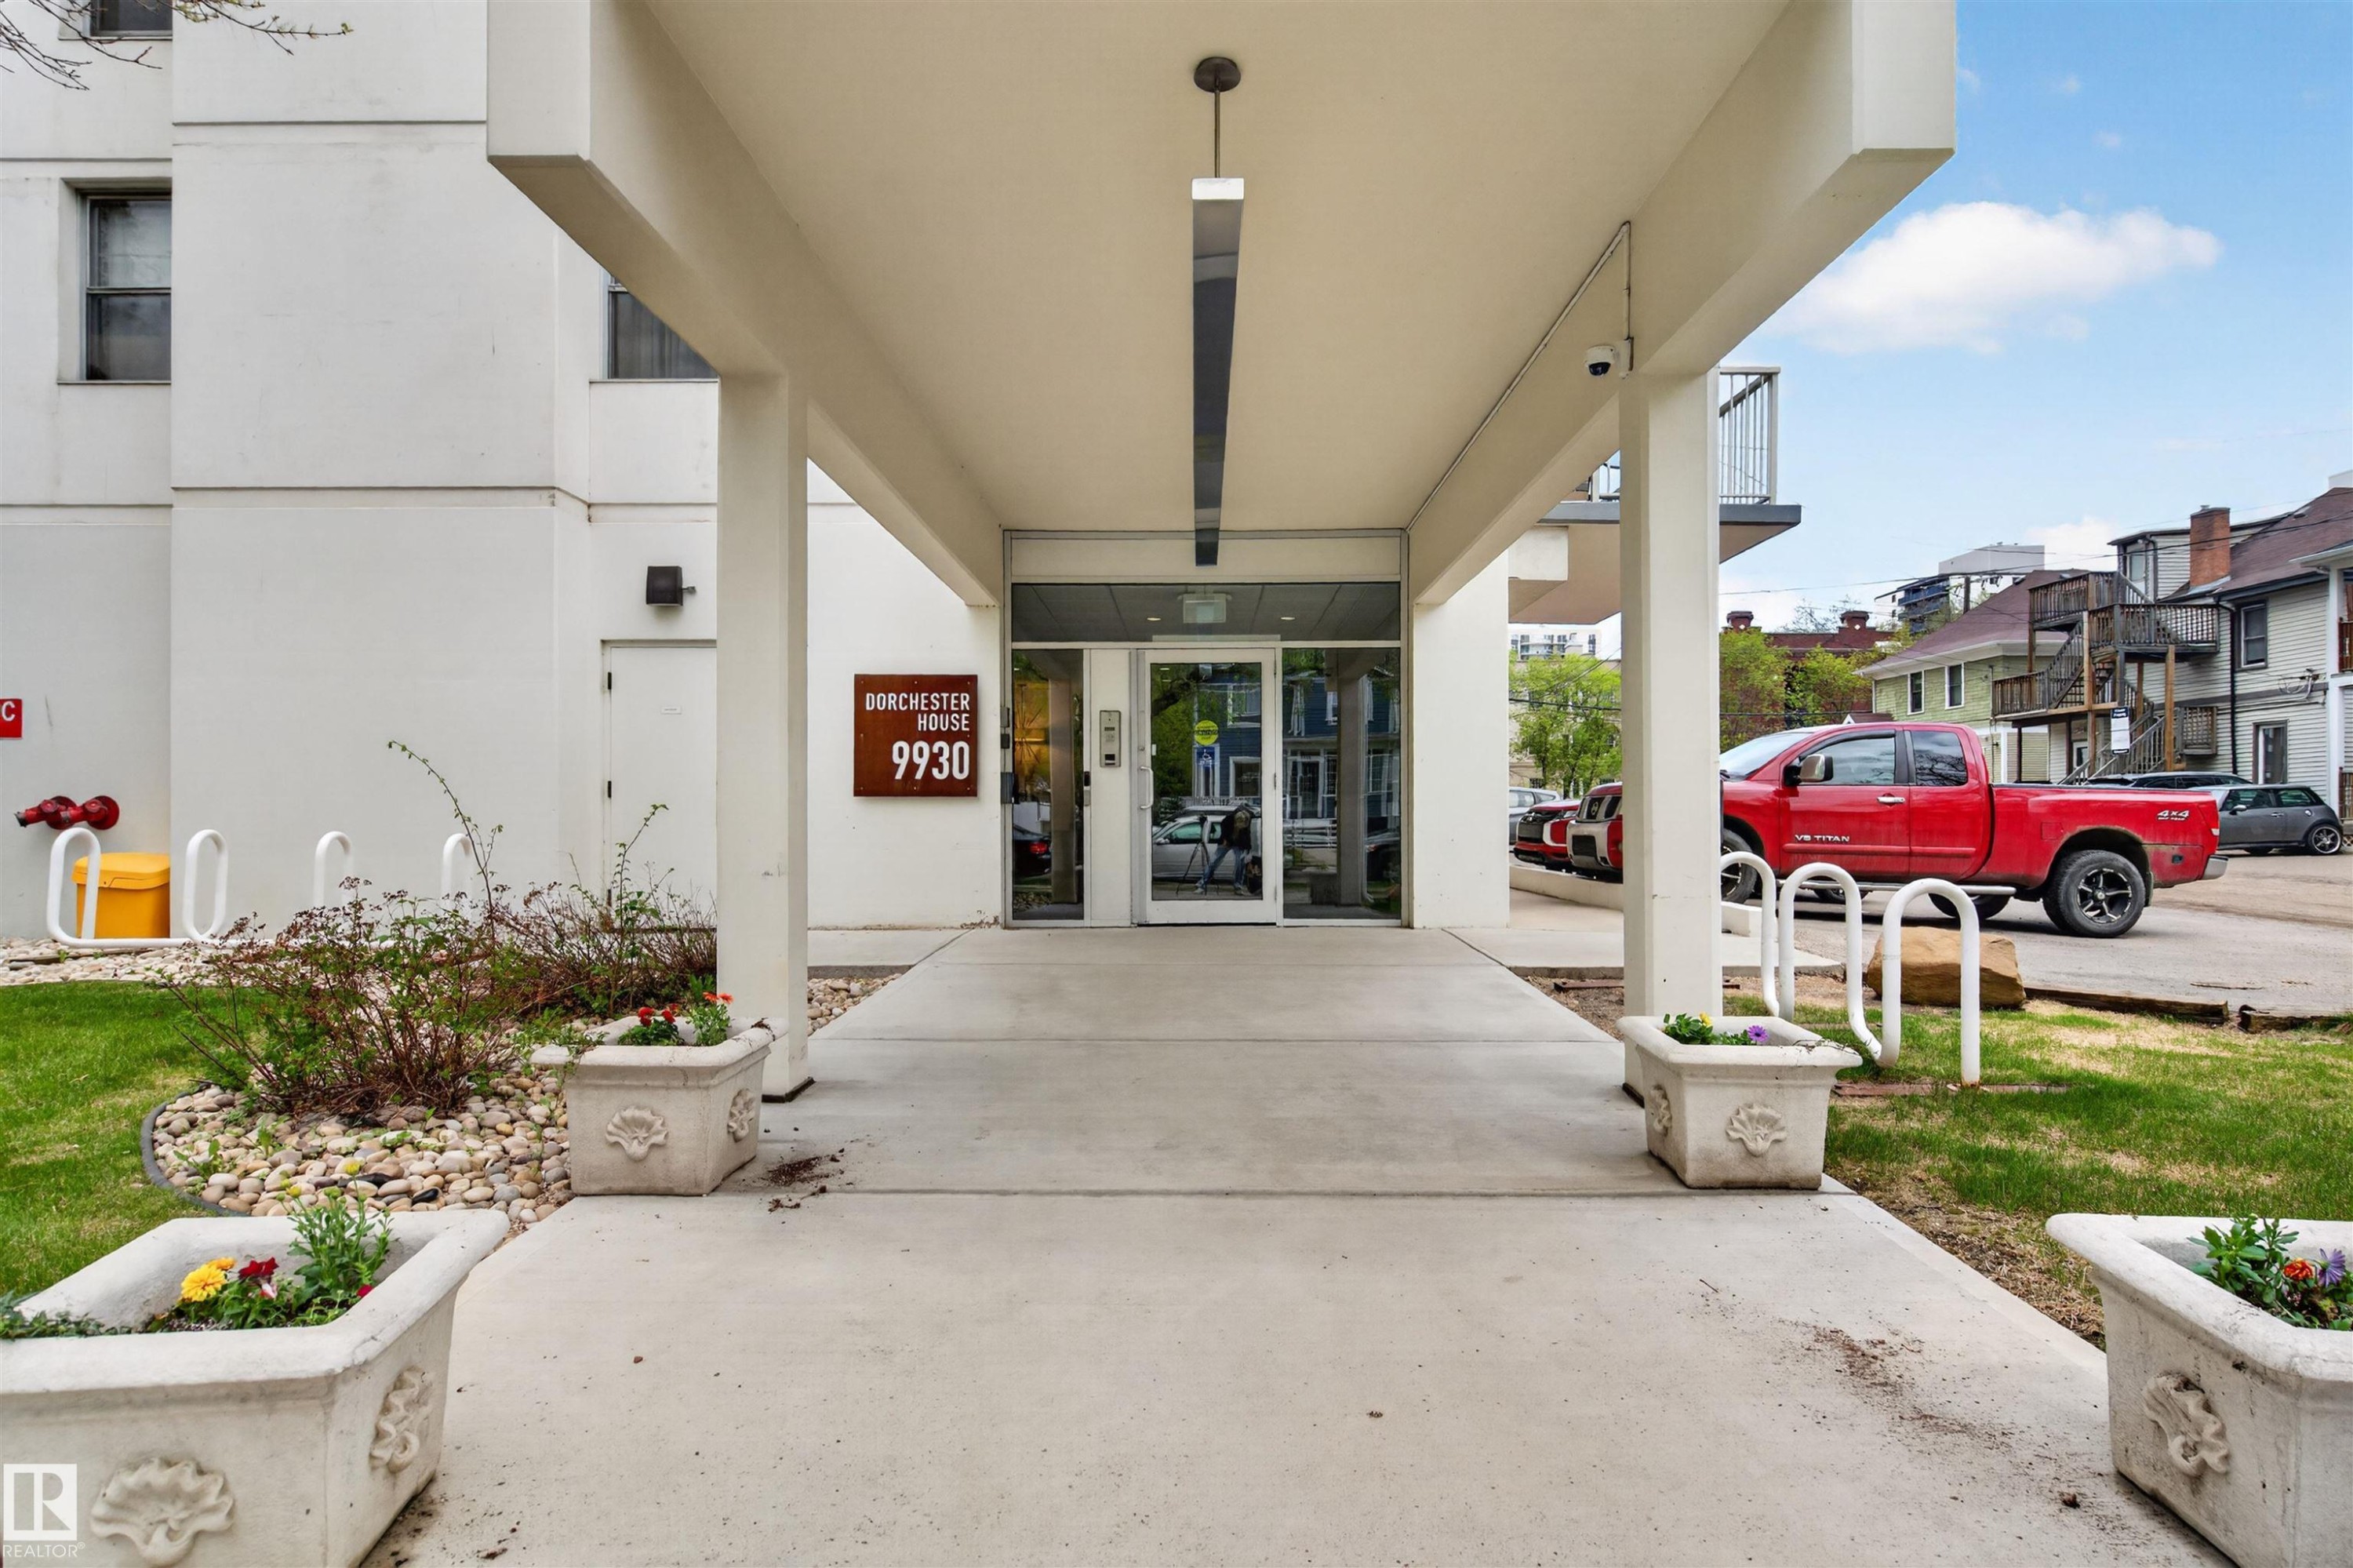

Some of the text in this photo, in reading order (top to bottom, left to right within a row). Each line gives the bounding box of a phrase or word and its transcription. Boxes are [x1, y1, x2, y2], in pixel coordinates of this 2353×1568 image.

[866, 693, 969, 711] DORCHESTER
[918, 713, 969, 731] HOUSE
[892, 740, 969, 780] 9930
